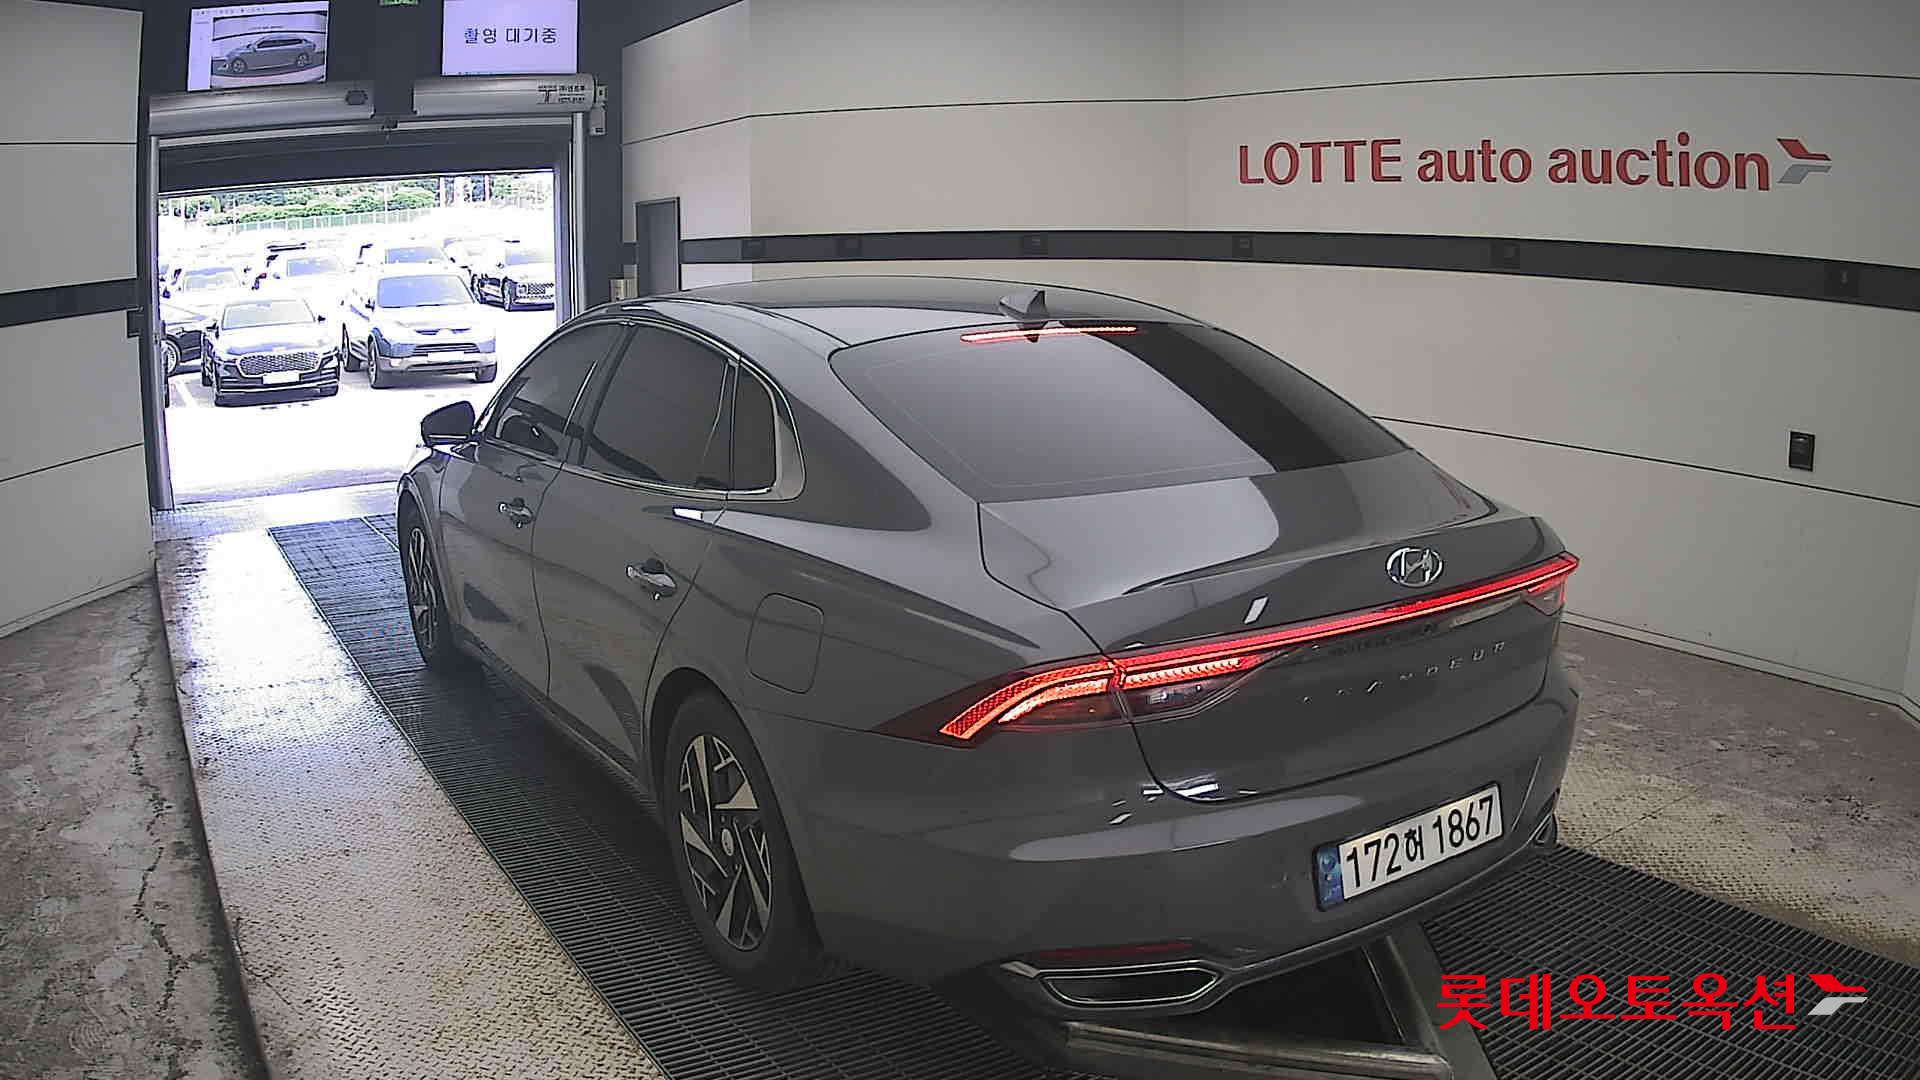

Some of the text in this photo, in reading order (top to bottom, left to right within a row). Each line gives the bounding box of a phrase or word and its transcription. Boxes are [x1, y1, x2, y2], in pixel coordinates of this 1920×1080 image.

[505, 27, 557, 45] 대기중
[1238, 131, 1771, 192] LOTTE auto auction
[1346, 794, 1494, 888] 172허 1867
